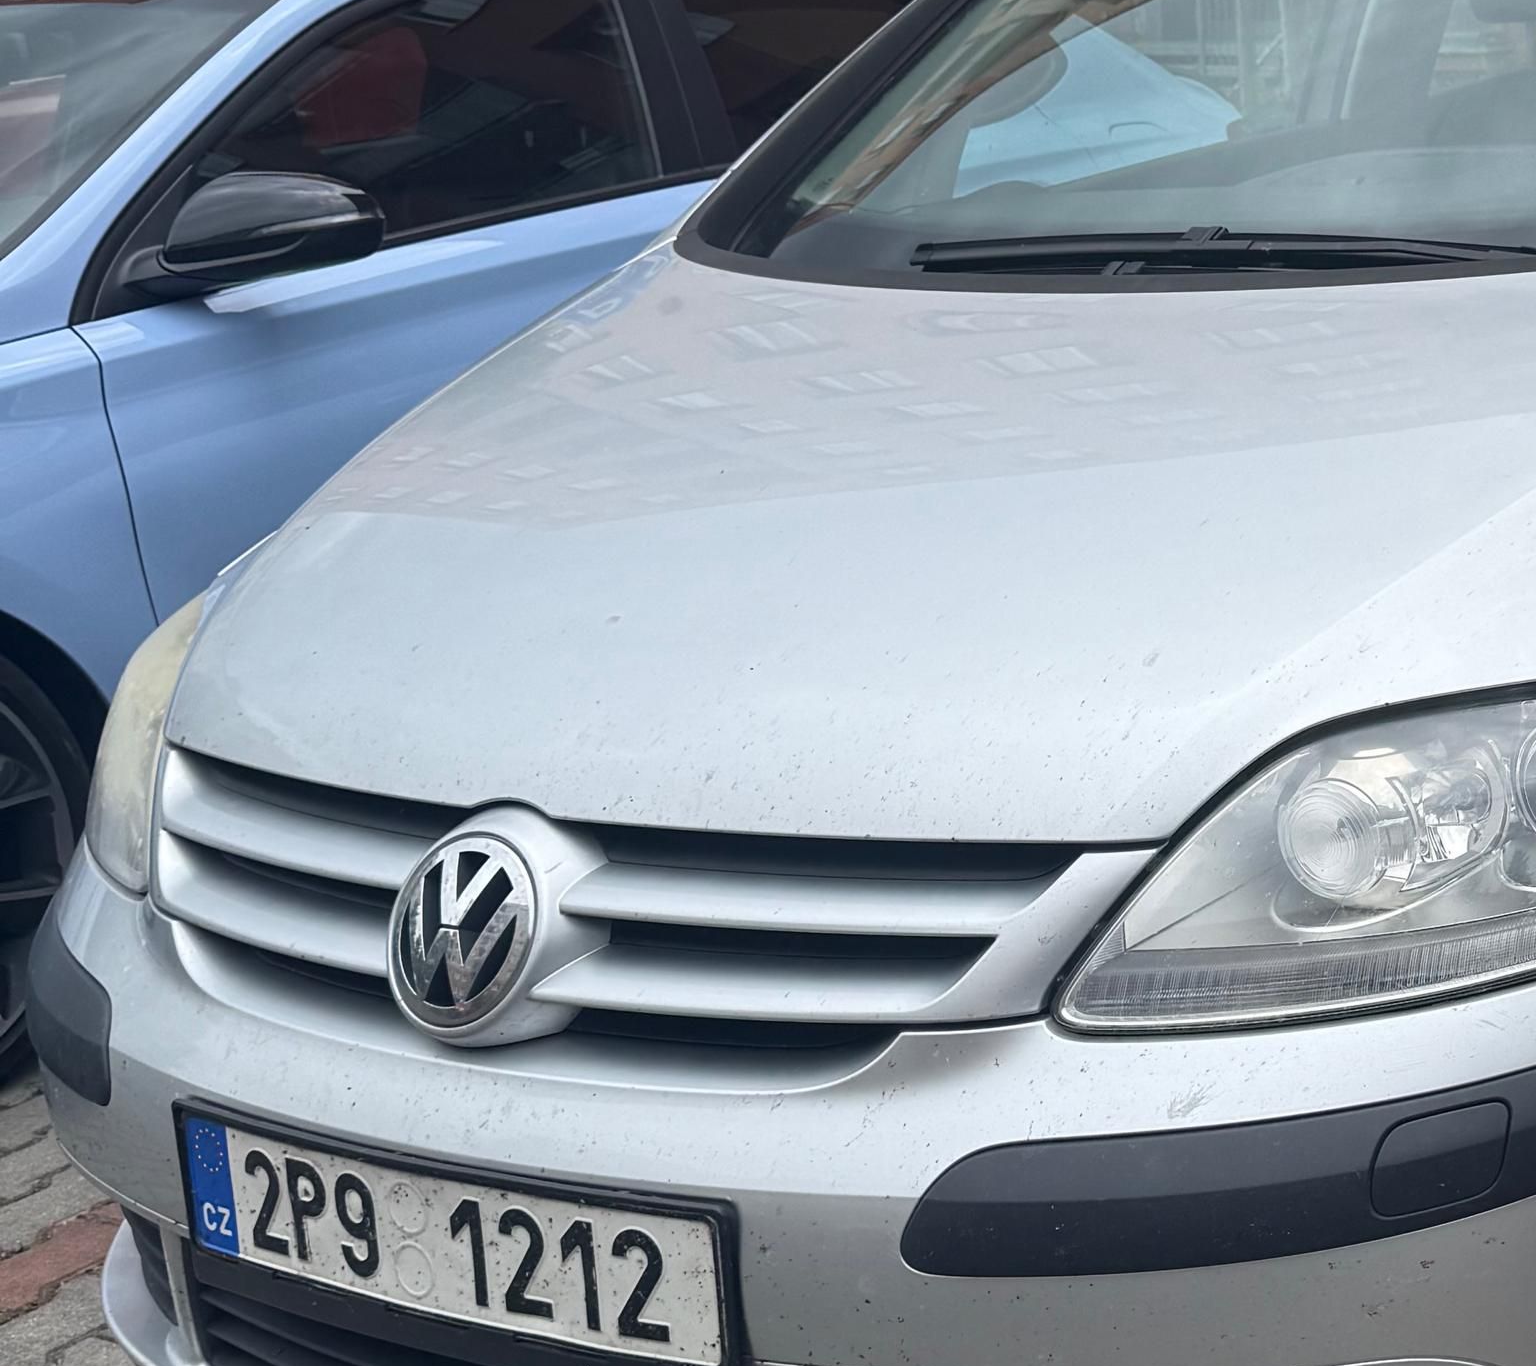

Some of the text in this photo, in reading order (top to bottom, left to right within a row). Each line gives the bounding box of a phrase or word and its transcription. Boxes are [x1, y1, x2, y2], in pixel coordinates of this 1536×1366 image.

[399, 838, 532, 1021] VW
[203, 1202, 232, 1237] CZ
[243, 1148, 671, 1343] 2P9 1212
